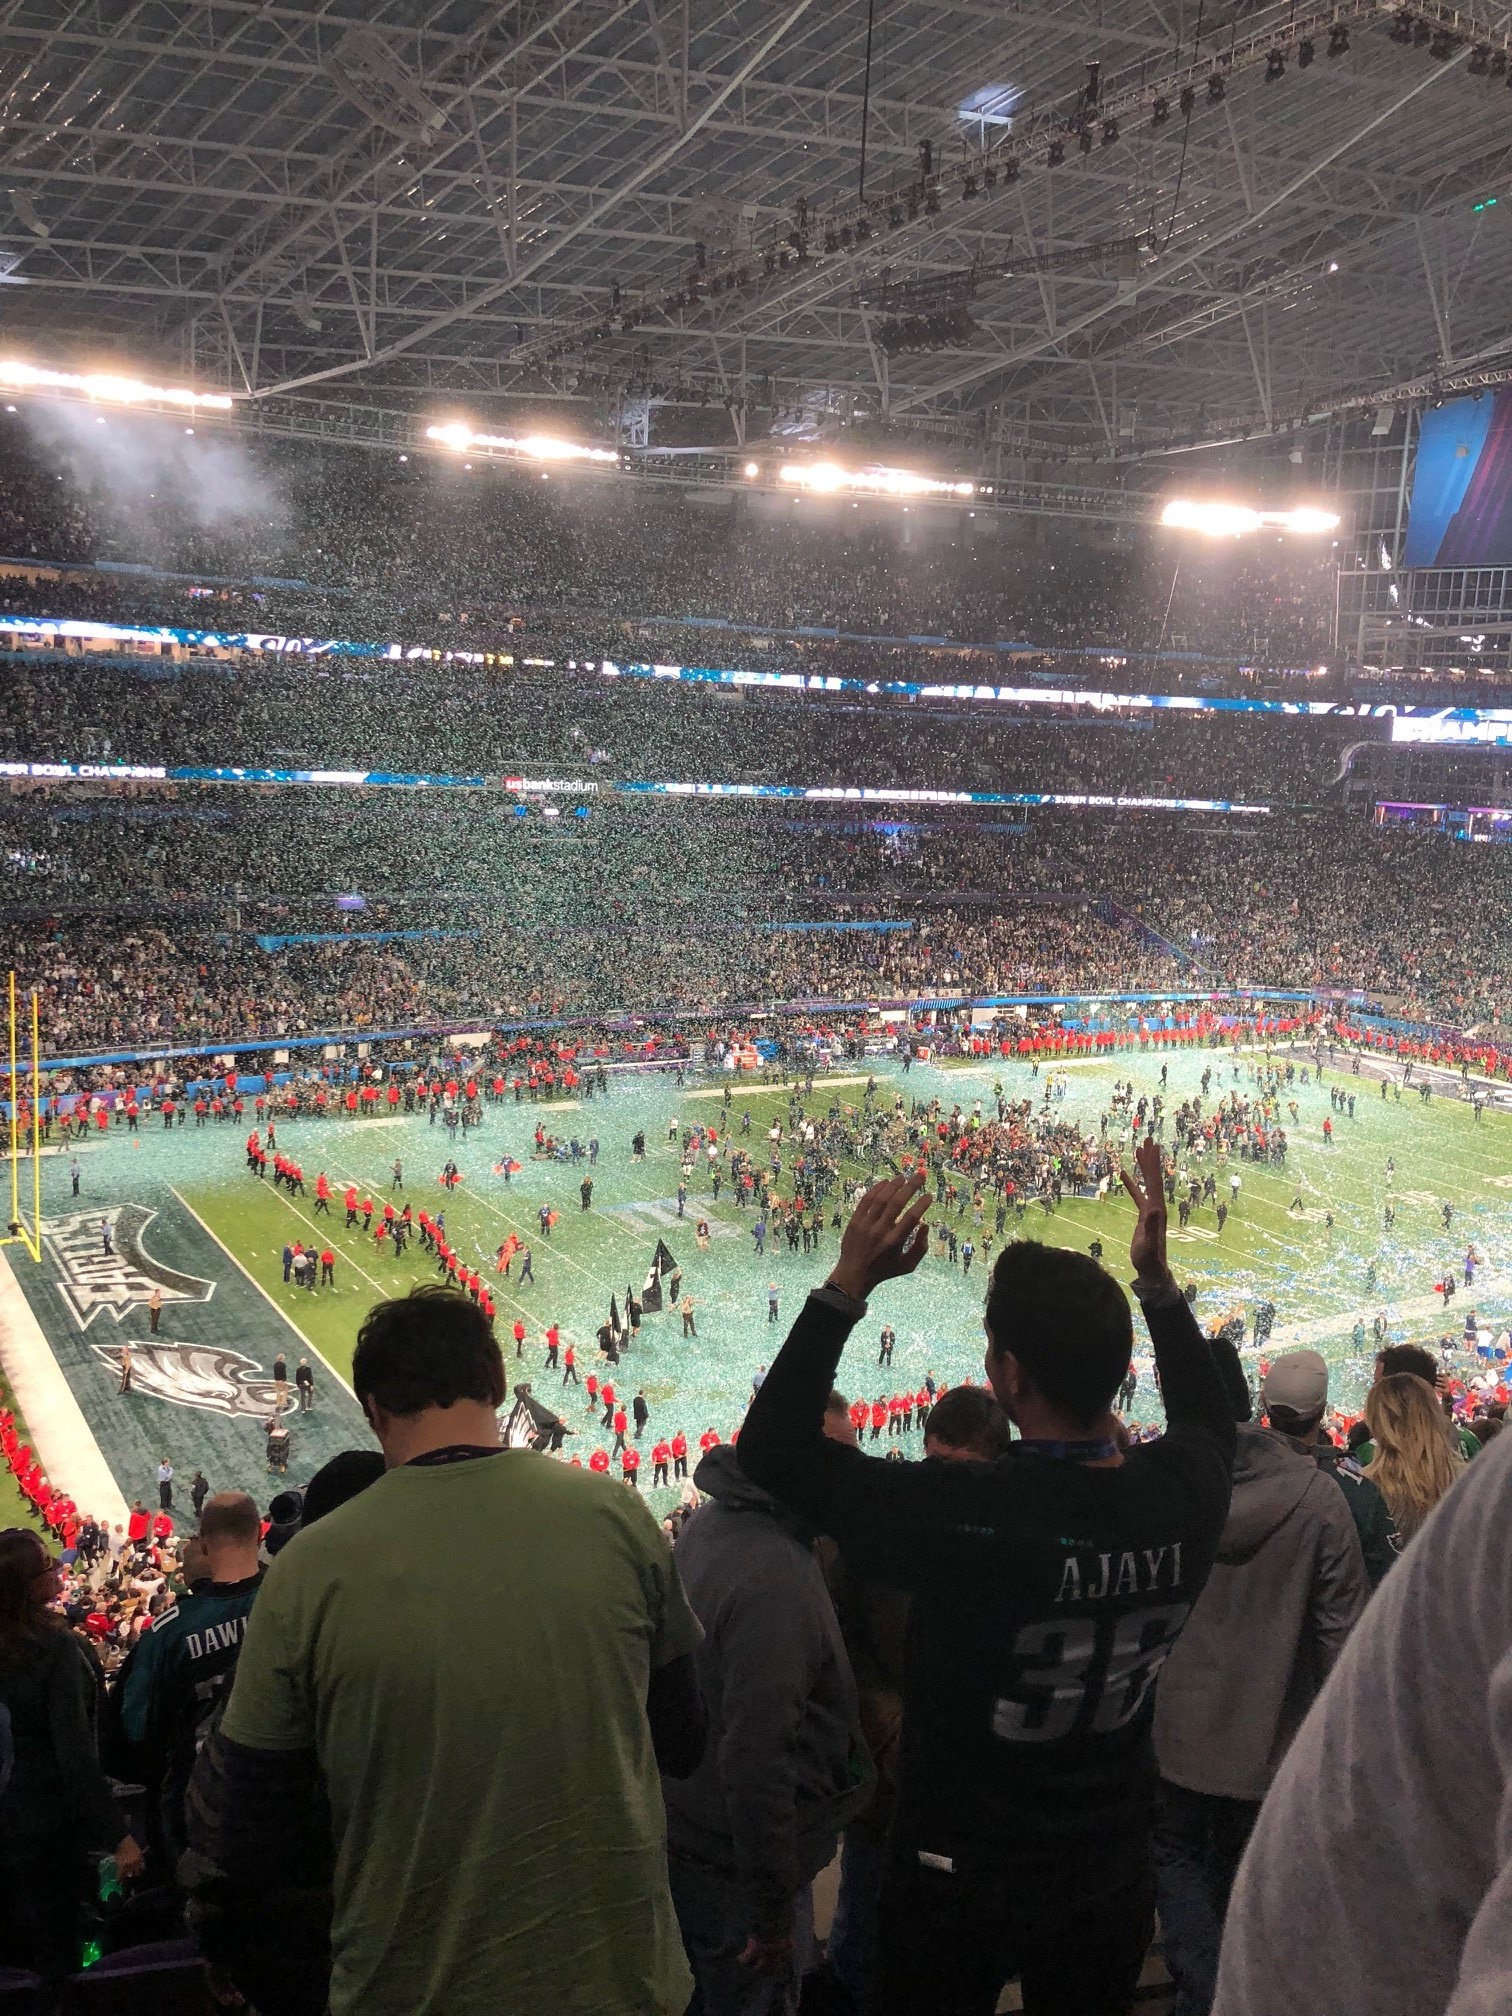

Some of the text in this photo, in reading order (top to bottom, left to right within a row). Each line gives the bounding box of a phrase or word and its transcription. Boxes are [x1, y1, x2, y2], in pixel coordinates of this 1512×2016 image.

[32, 764, 76, 777] BOWL
[79, 766, 166, 778] CHAMPIONS
[1054, 796, 1087, 805] SUPER
[1089, 797, 1115, 806] BOWL
[1117, 798, 1176, 808] CHAMPIONS
[1166, 1226, 1220, 1243] 50
[1055, 1543, 1183, 1602] AJAYI
[992, 1603, 1191, 1742] 36
